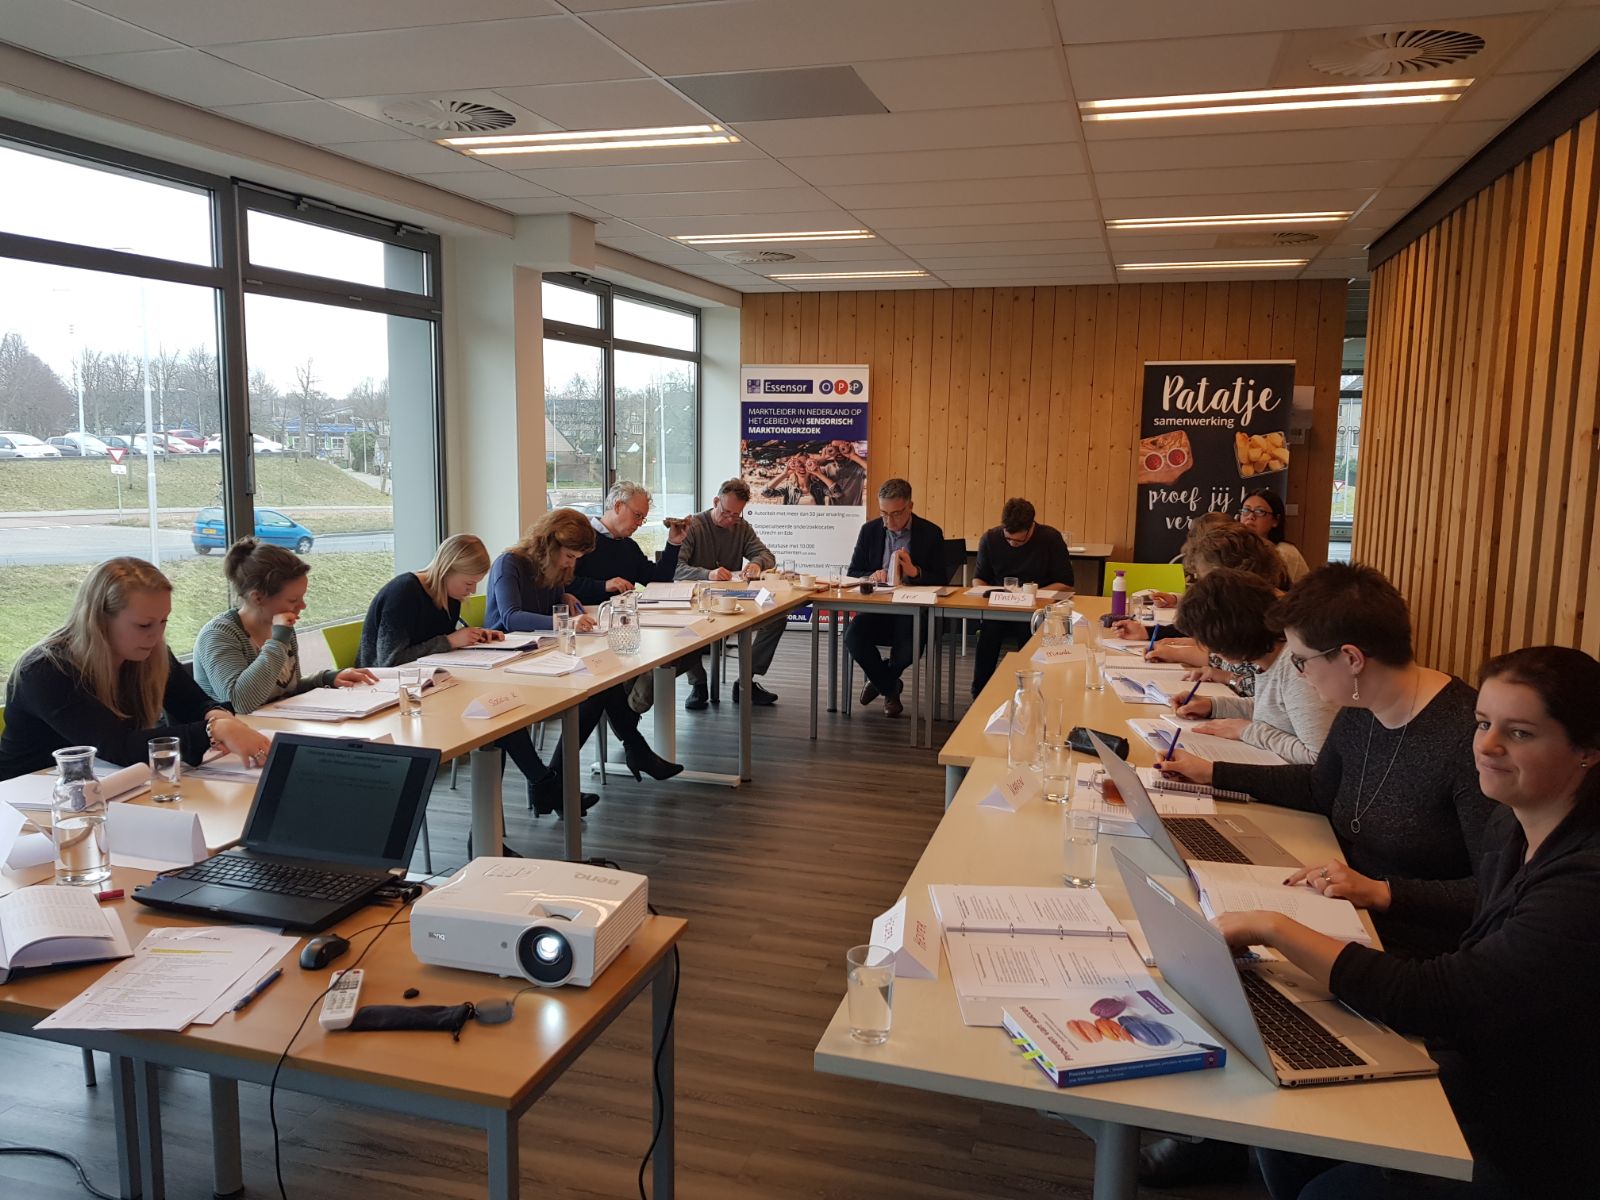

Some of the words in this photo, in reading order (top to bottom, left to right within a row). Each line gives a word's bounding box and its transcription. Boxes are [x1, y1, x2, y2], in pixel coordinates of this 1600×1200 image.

[765, 381, 807, 392] Essensor
[1163, 375, 1281, 426] Patatje
[1153, 416, 1235, 429] samenwerking
[1149, 486, 1202, 512] proef
[1208, 486, 1234, 512] jij
